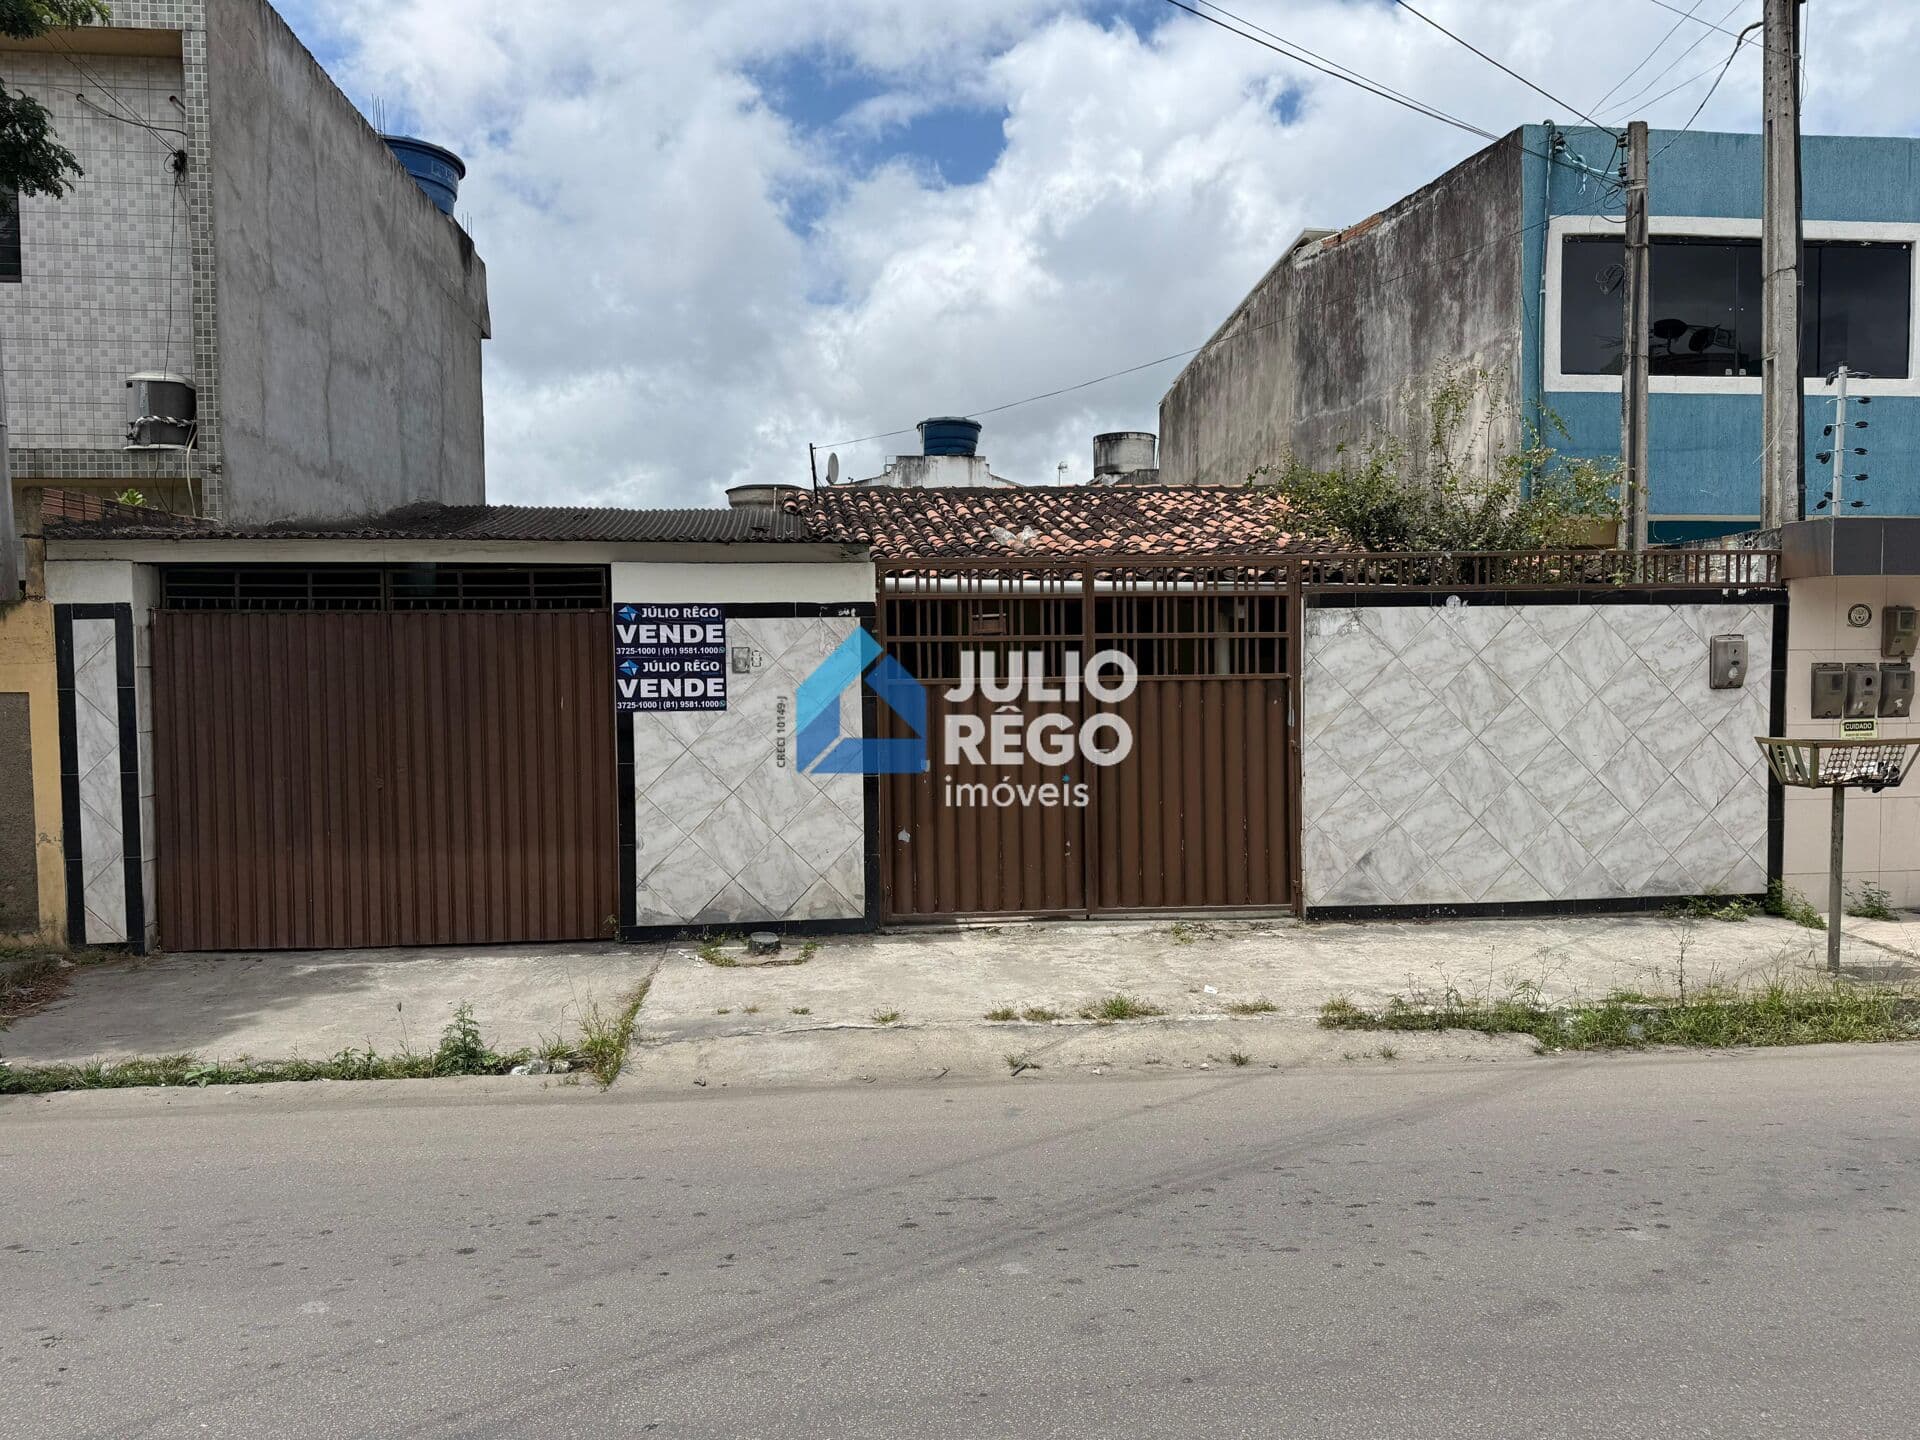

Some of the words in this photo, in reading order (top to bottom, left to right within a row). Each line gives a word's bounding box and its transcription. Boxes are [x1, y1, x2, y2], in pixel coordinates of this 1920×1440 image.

[641, 605, 679, 618] JÚLIO
[683, 605, 719, 618] RÊGO
[616, 624, 724, 644] VENDE
[616, 647, 656, 655] 3725-1000
[662, 647, 678, 655] (81)
[642, 659, 680, 673] JÚLIO
[684, 659, 720, 672] RÊGO
[617, 678, 725, 698] VENDE
[617, 701, 657, 709] 3725-1000
[663, 701, 678, 710] (81)
[1845, 722, 1872, 730] CUIDADO
